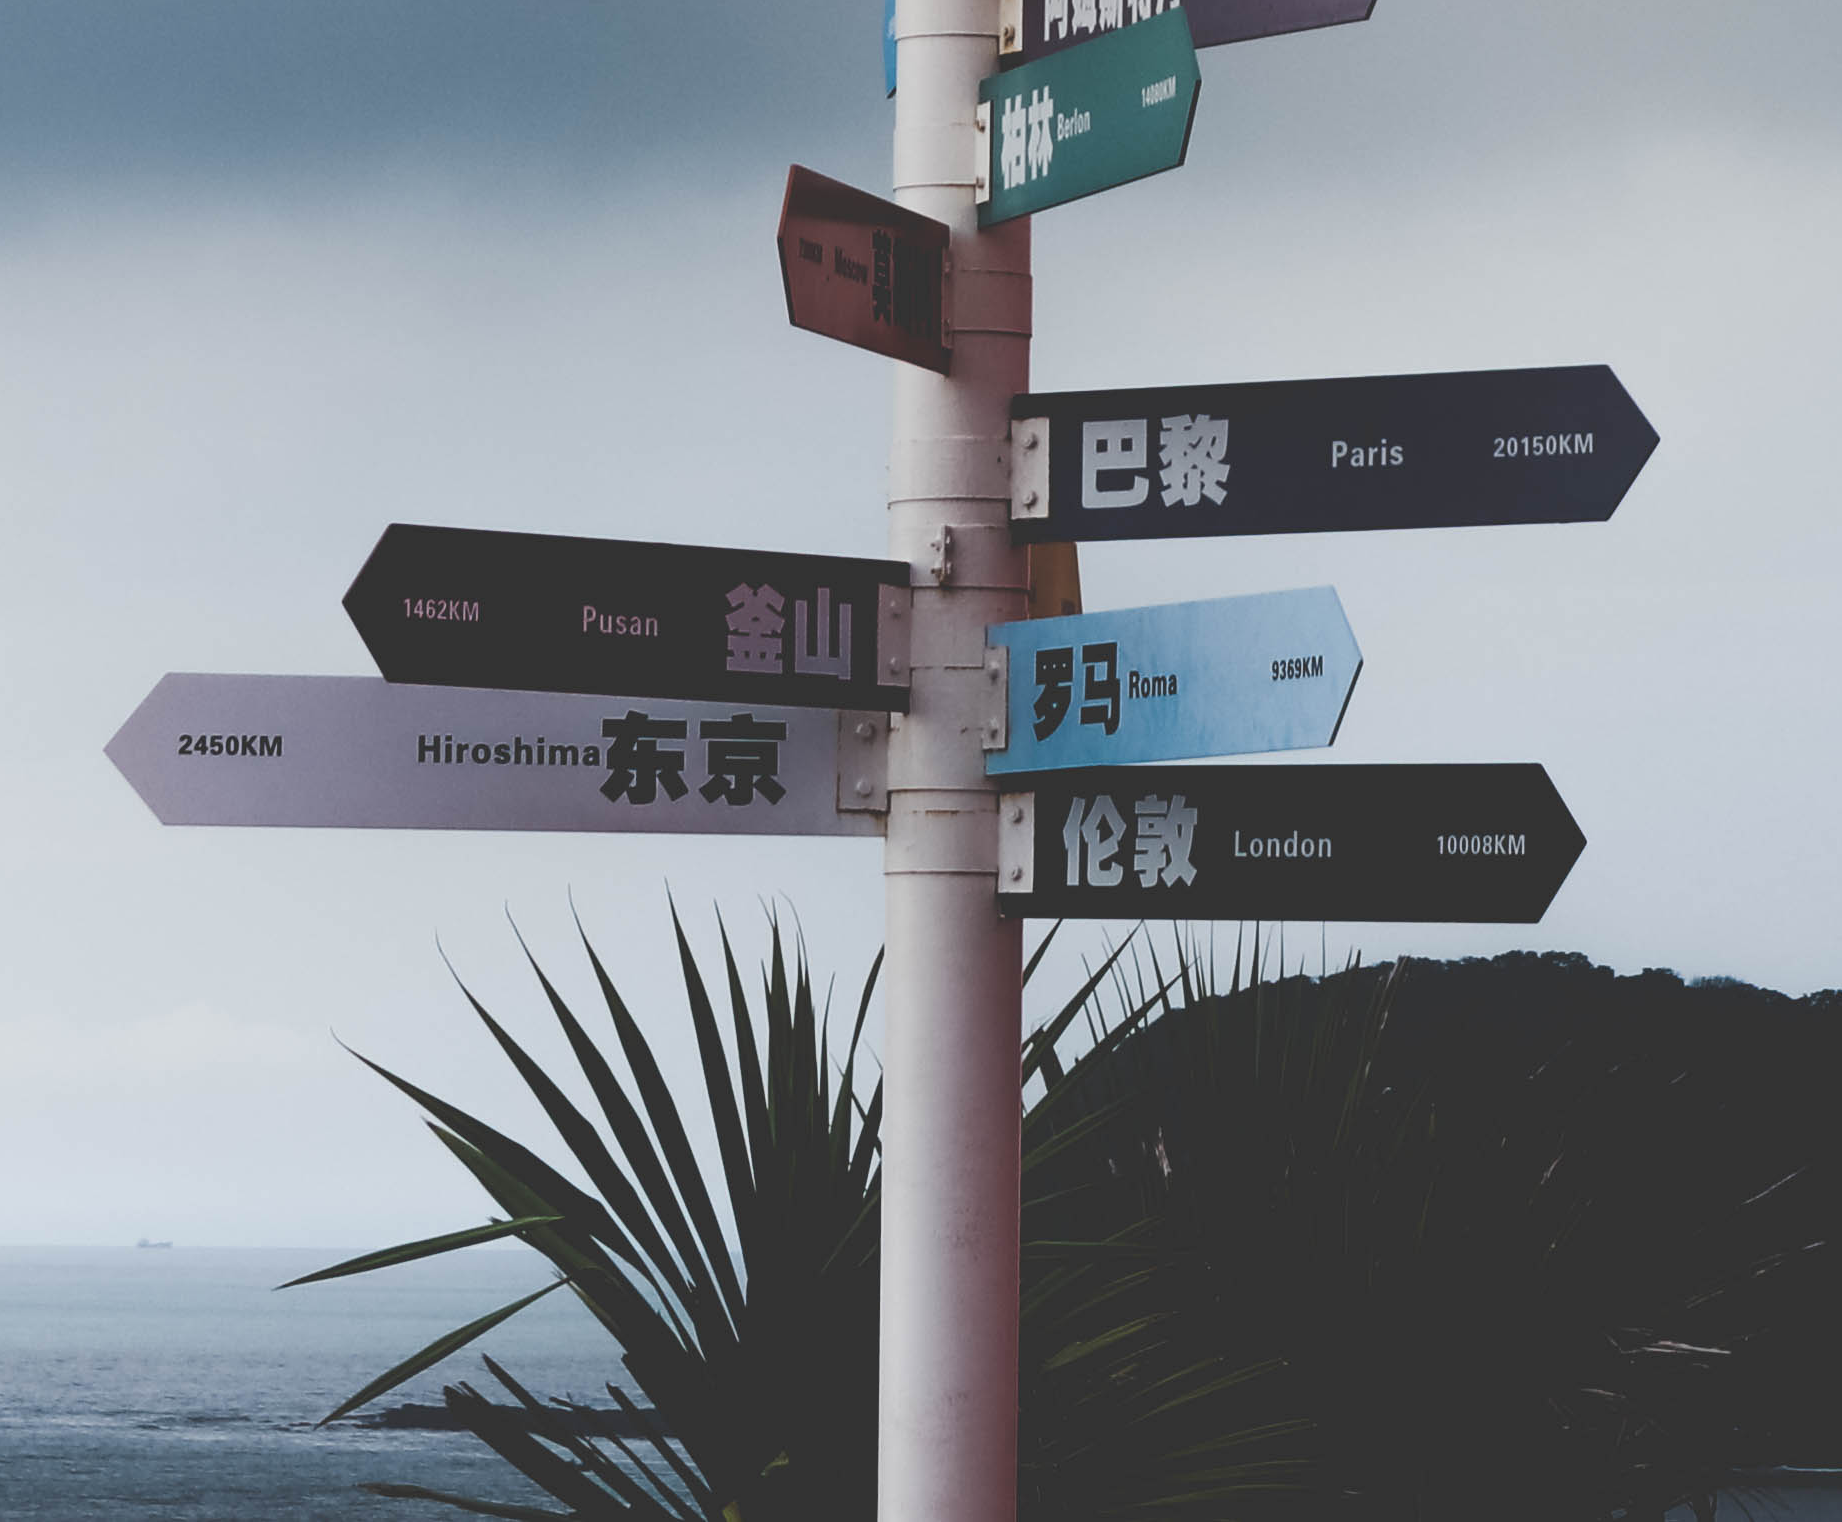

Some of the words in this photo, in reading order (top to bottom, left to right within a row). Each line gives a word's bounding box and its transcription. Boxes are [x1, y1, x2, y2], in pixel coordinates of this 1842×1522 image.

[1001, 85, 1054, 191] 柏林
[1081, 414, 1231, 509] 巴黎
[1331, 438, 1404, 468] Paris
[1493, 432, 1594, 459] 20150KM
[403, 598, 480, 623] 1462KM
[582, 605, 659, 637] Pusan
[724, 582, 853, 681] 釜山
[1032, 641, 1121, 743] 罗马
[1128, 670, 1178, 700] Roma
[1271, 655, 1324, 682] 9369KM
[178, 734, 284, 758] 2450KM
[416, 734, 600, 768] Hiroshima
[600, 709, 788, 807] 东京
[1062, 794, 1198, 888] 伦敦
[1234, 830, 1332, 859] London
[1437, 834, 1526, 856] 10008KM
